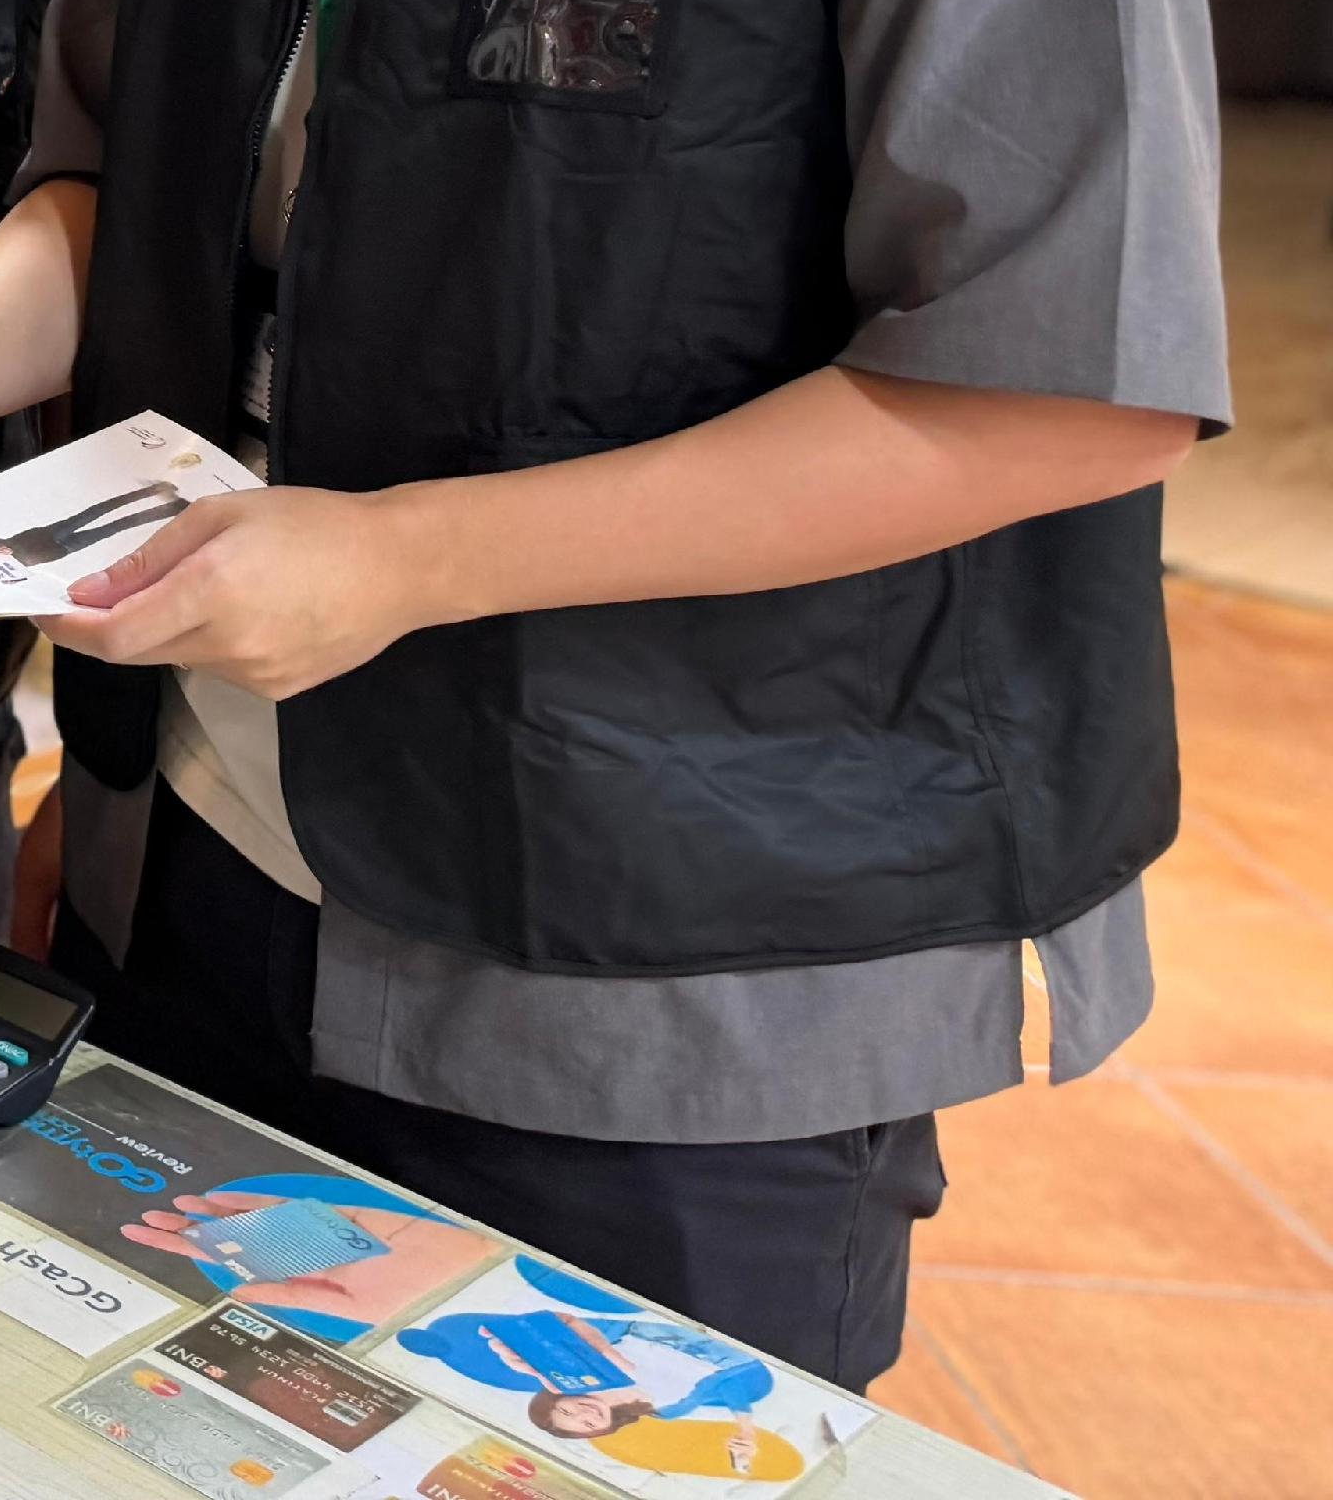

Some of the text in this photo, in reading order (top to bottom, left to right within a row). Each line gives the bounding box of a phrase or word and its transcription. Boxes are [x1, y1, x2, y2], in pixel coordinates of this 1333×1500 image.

[115, 1135, 193, 1175] Review
[229, 1309, 269, 1336] VISA
[165, 1344, 206, 1369] BNI
[252, 1346, 288, 1368] 1234
[257, 1365, 326, 1404] PLATINUM
[67, 1401, 111, 1427] BNI
